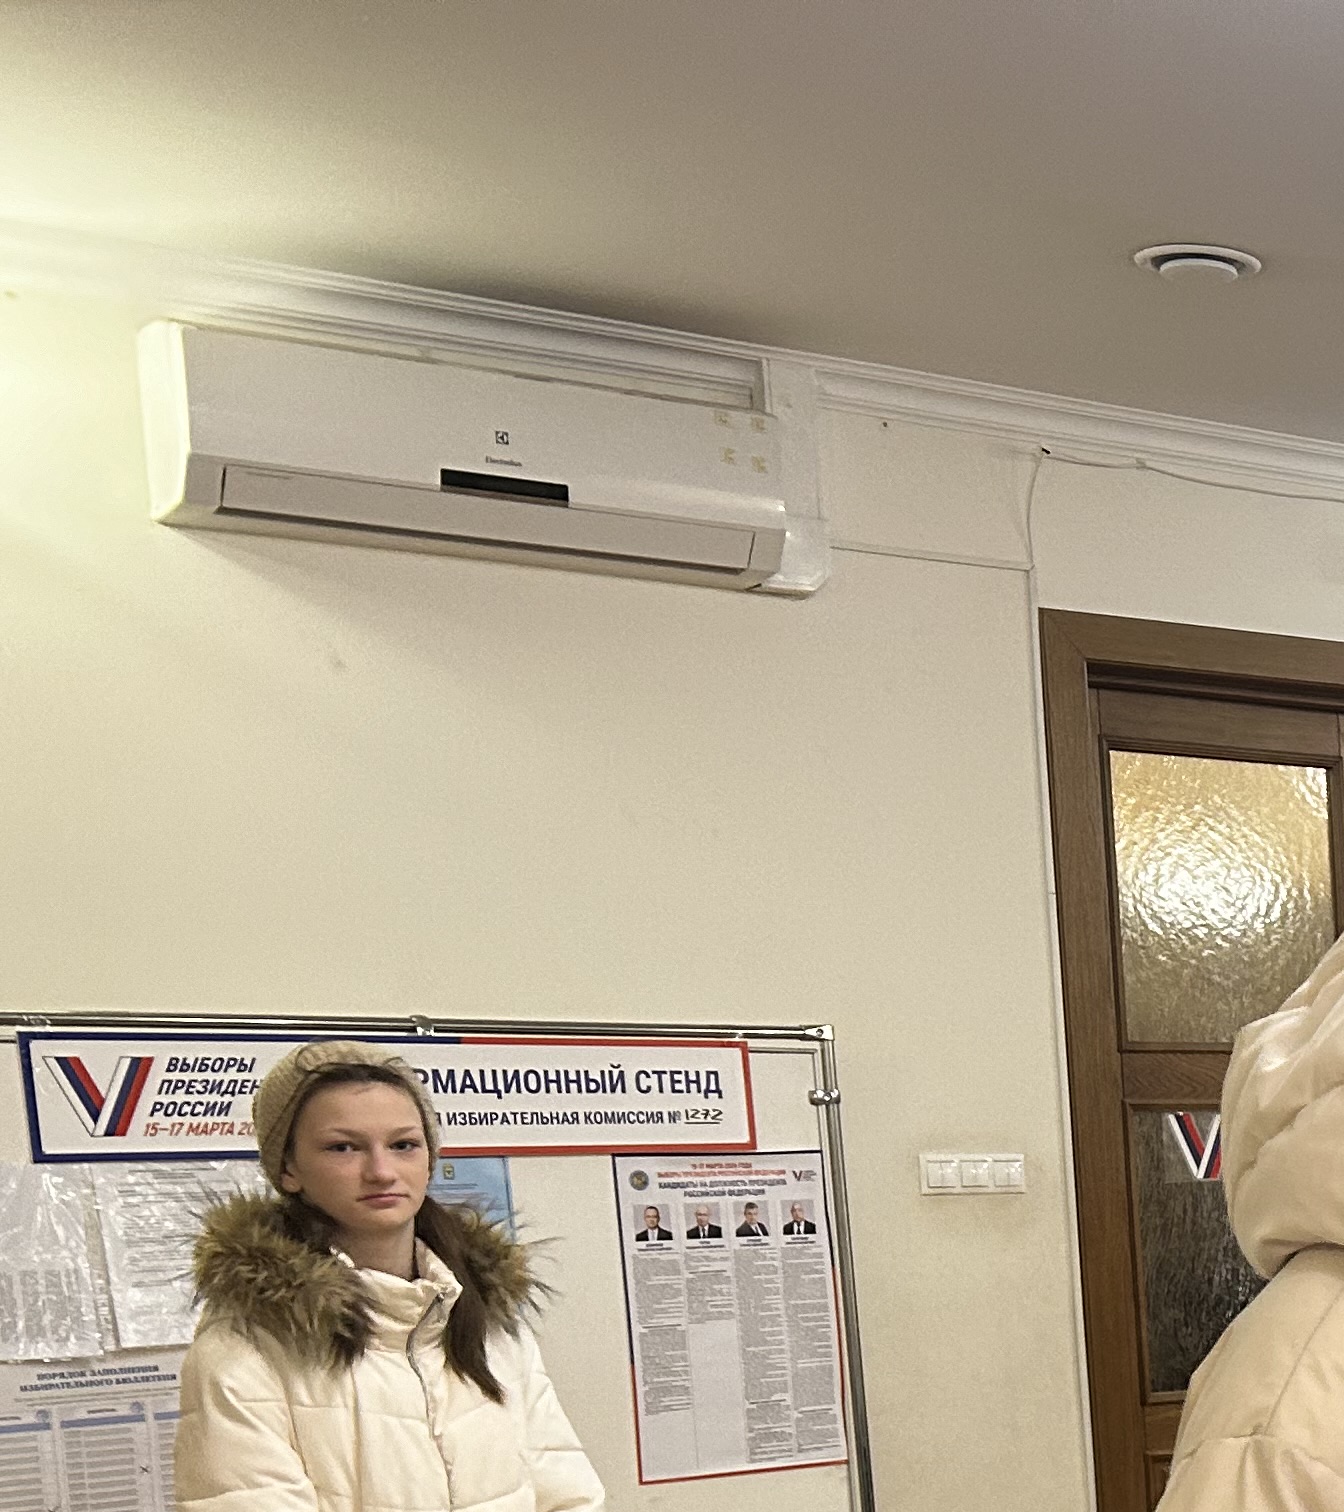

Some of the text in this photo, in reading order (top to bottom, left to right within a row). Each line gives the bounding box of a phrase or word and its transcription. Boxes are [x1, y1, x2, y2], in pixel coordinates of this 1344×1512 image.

[165, 1056, 256, 1073] ВЫБОРЫ
[157, 1078, 261, 1097] ПРЕЗИДЕН
[413, 1063, 723, 1099] РМАЦИОННЫЙ СТЕНД
[149, 1100, 232, 1117] РОССИИ
[446, 1111, 580, 1126] ИЗБИРАТЕЛЬНАЯ
[584, 1110, 664, 1125] КОМИССИЯ
[668, 1111, 681, 1124] №
[684, 1108, 723, 1122] 1272
[186, 1121, 235, 1136] МАРТА
[238, 1121, 256, 1136] 20
